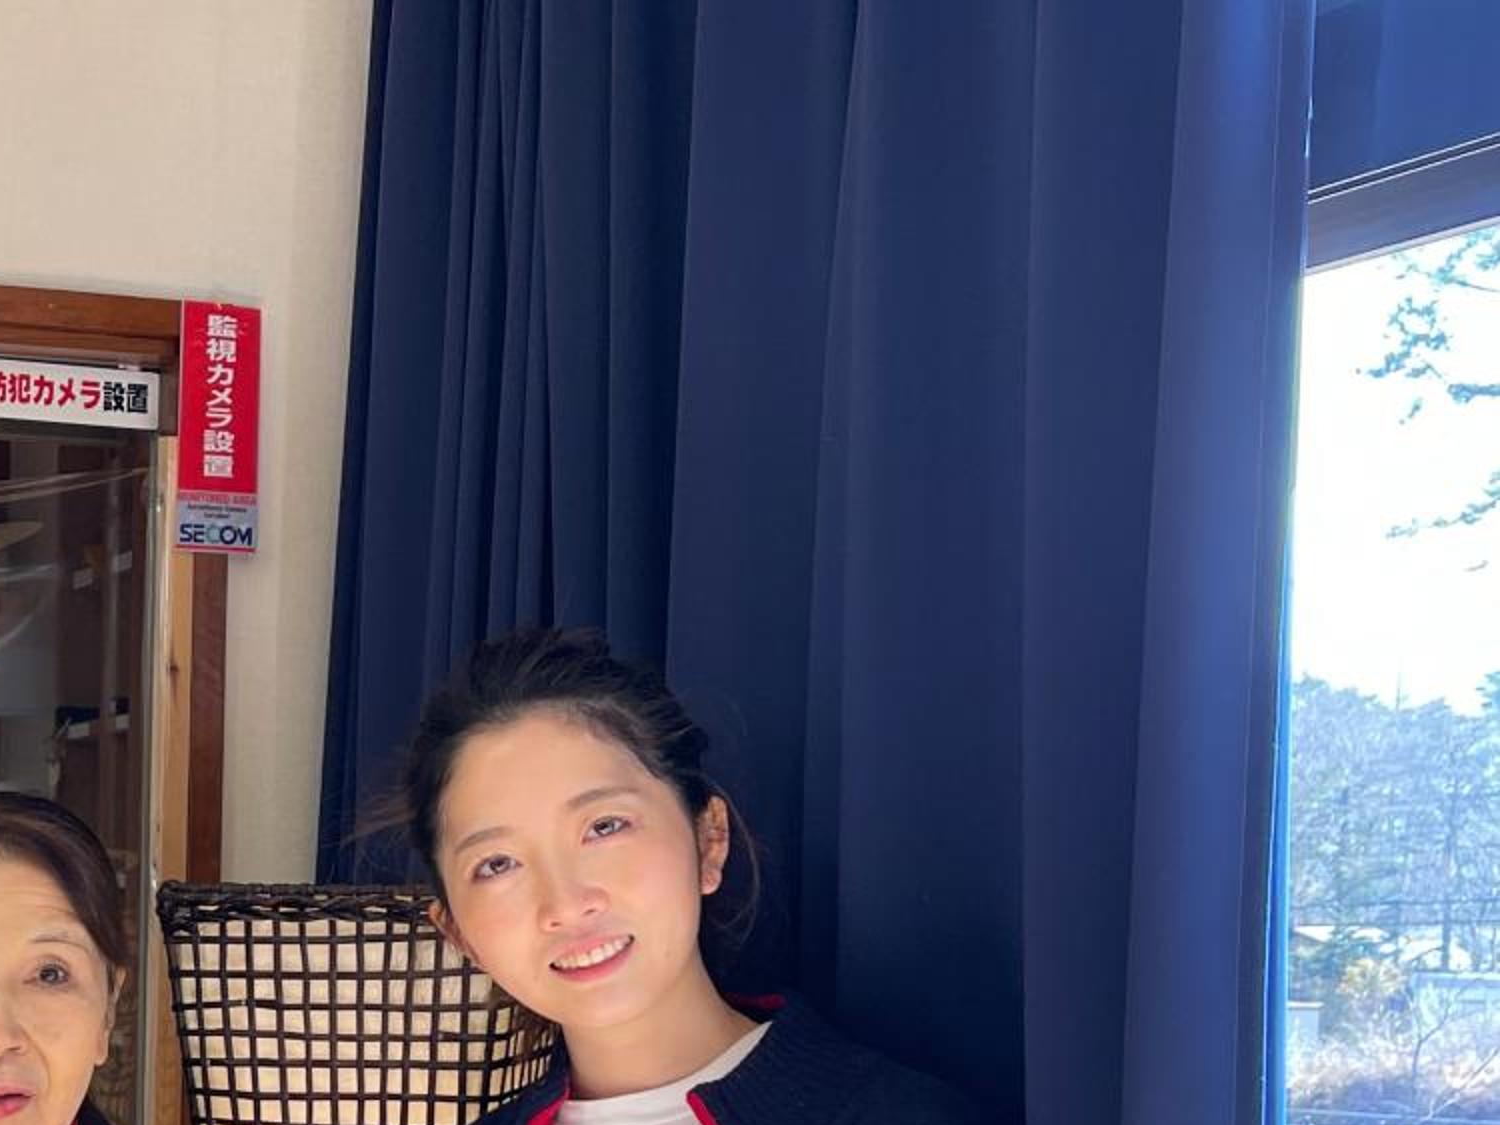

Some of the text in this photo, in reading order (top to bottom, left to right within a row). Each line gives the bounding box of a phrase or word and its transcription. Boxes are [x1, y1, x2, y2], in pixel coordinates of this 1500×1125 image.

[203, 313, 238, 478] 監視カメラ設置
[179, 523, 253, 546] SECOM
